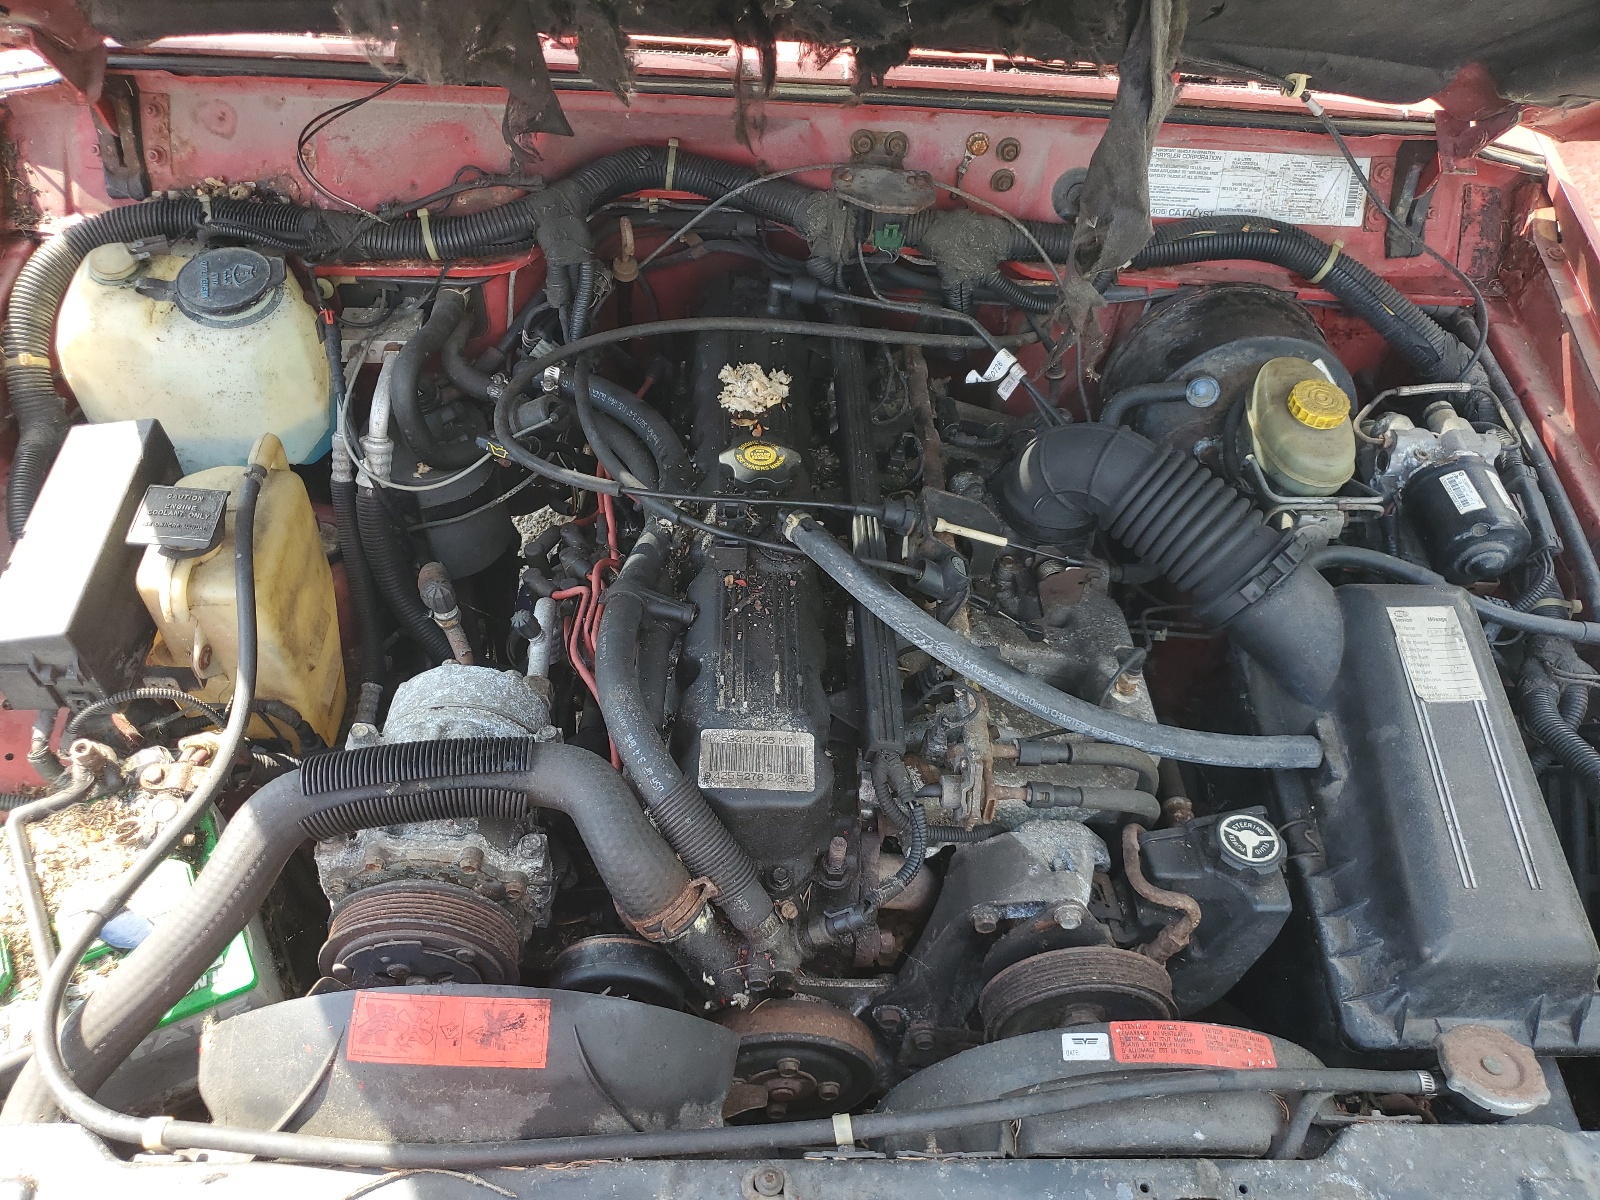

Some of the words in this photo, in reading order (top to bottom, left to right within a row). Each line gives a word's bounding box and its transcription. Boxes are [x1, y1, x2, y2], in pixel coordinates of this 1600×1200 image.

[167, 493, 204, 502] CAUTION
[165, 503, 198, 511] ENGINE
[148, 509, 184, 517] COOLANT
[1232, 822, 1265, 835] STEERING
[1229, 835, 1246, 852] POWER
[1255, 842, 1270, 855] FLUID
